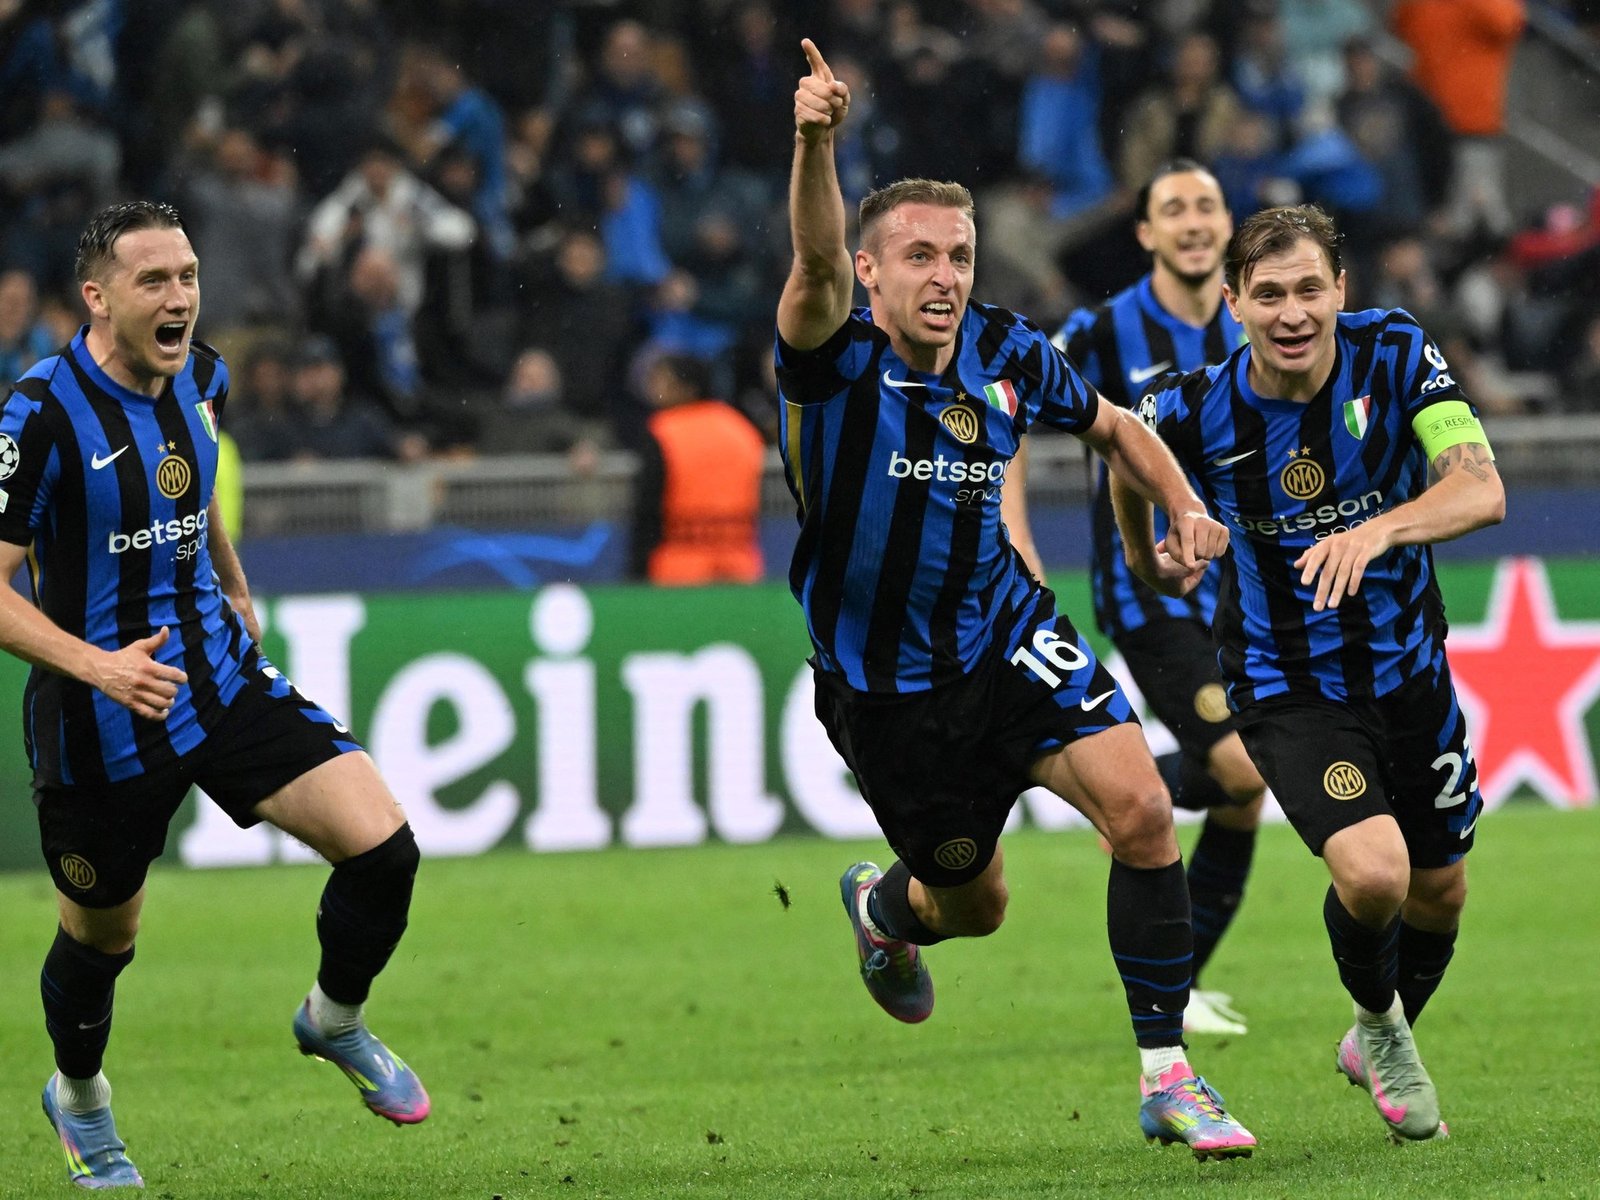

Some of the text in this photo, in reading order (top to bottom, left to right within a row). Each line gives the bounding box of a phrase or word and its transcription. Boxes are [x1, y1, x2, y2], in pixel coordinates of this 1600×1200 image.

[888, 451, 1011, 482] betsso
[109, 505, 209, 554] betsso
[1010, 629, 1089, 689] 16
